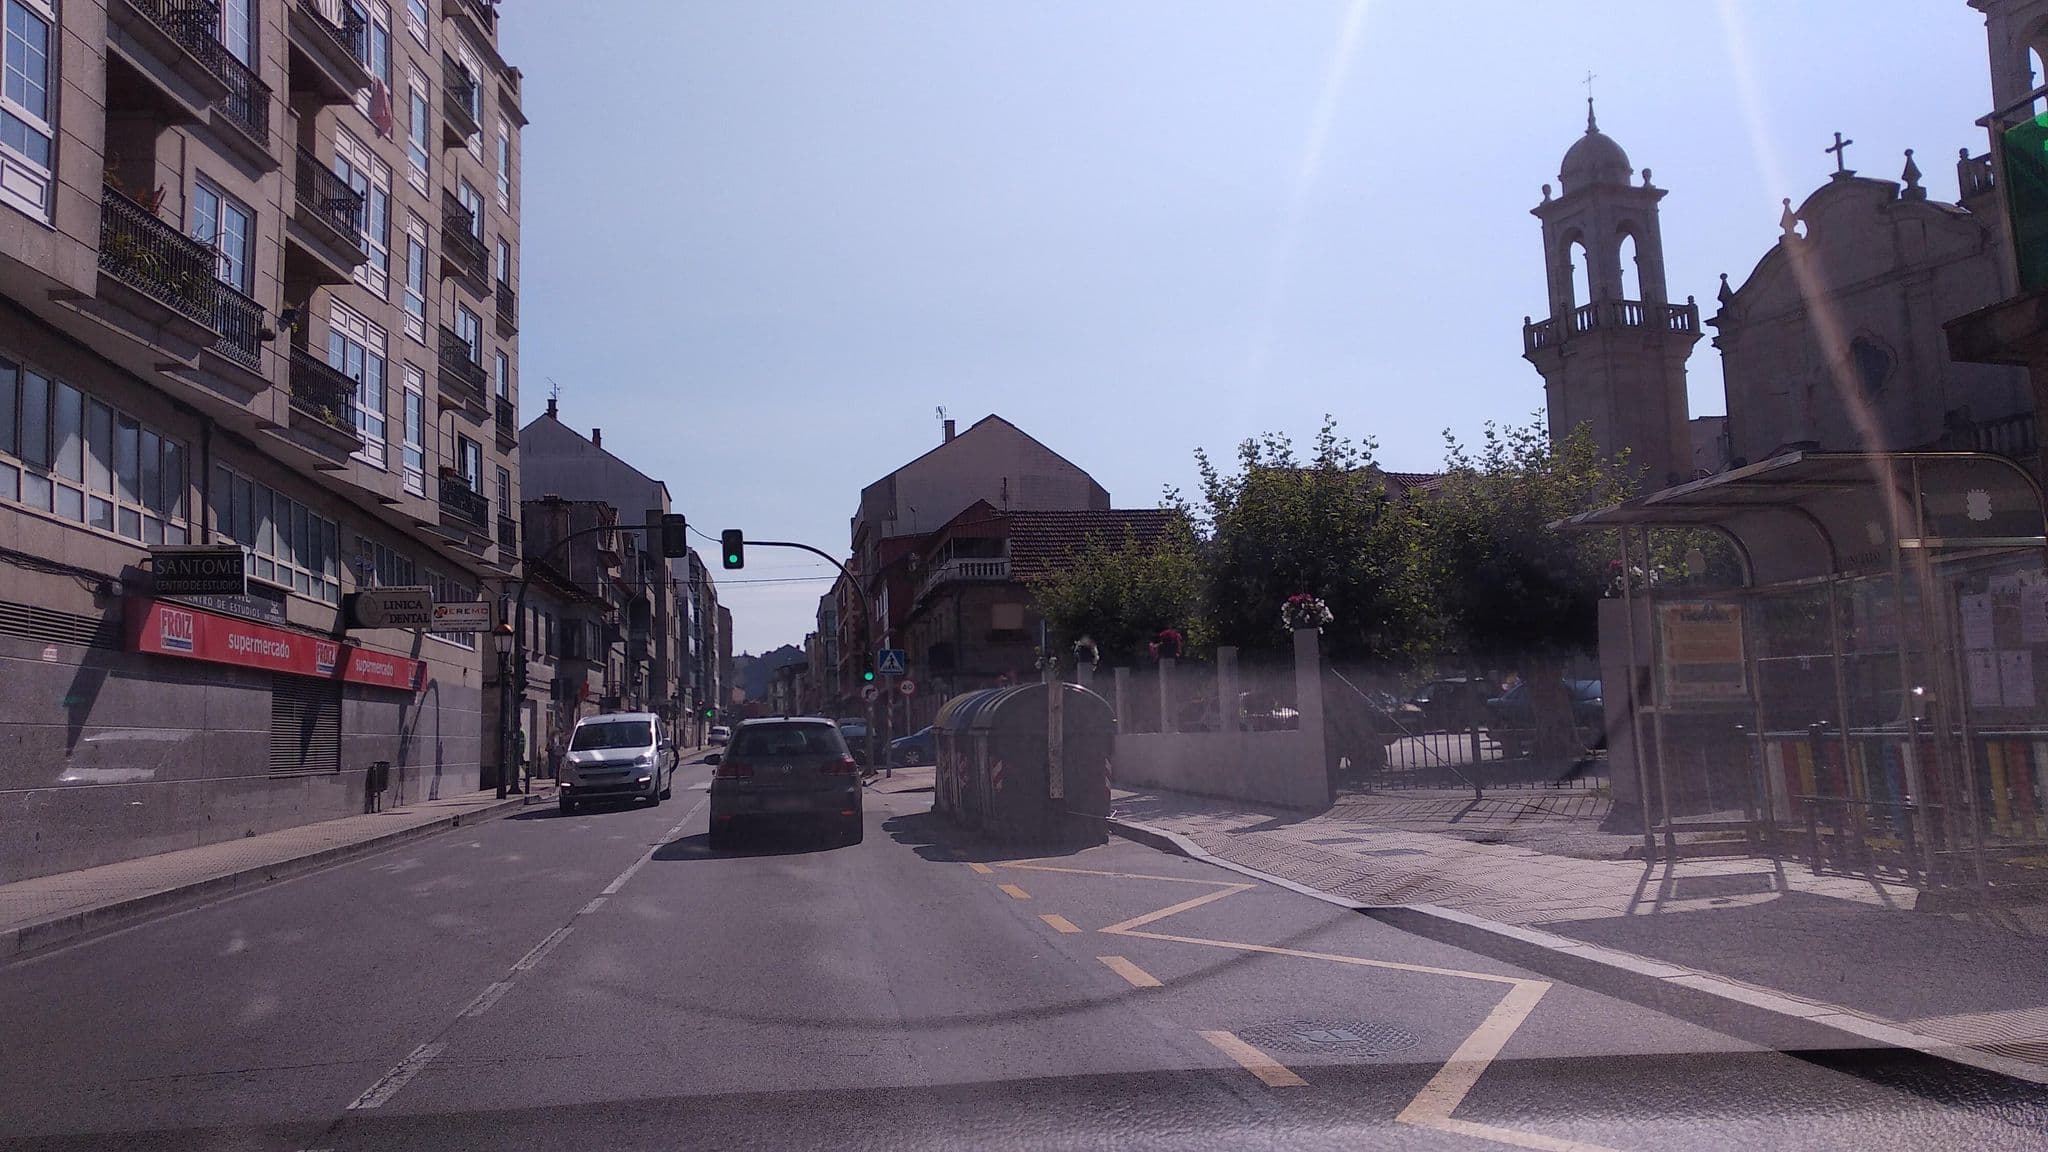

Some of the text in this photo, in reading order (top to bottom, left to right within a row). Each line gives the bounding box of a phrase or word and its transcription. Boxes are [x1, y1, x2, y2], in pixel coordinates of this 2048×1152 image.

[156, 580, 241, 591] CENTRO DE ESTUDIOS
[230, 602, 260, 618] ESTUDIOS
[390, 612, 431, 624] DENTAL
[162, 609, 193, 638] FROIZ
[228, 633, 290, 659] supermercado
[355, 658, 394, 678] supermercado
